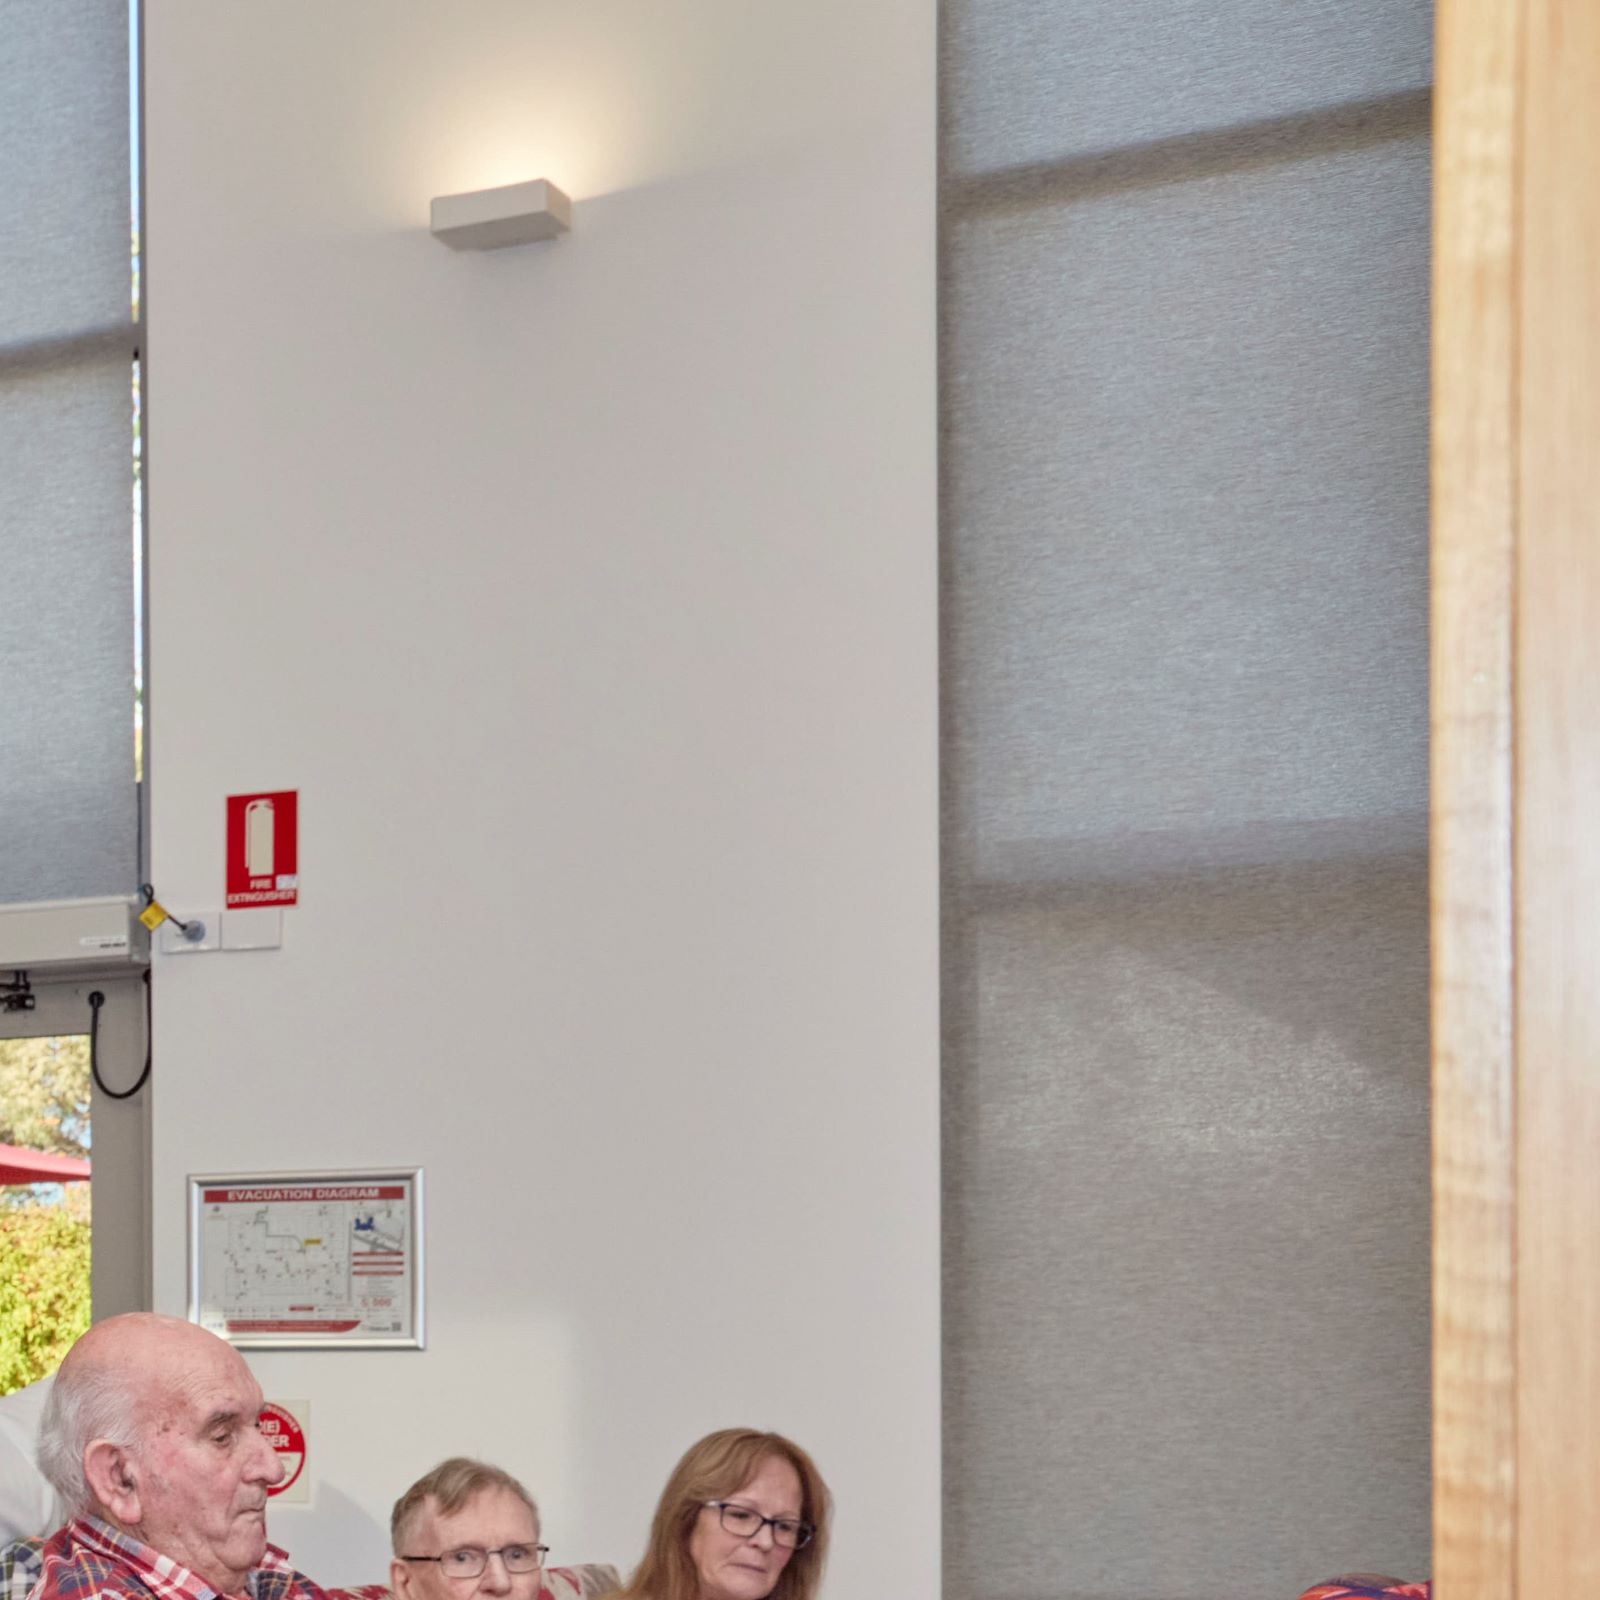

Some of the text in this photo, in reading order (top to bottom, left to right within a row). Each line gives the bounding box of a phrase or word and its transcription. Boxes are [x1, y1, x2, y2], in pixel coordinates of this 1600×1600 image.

[249, 878, 272, 890] FIRE
[227, 890, 296, 904] EXTINGUISHER
[227, 1187, 380, 1201] EVACUATION DIAGRAM
